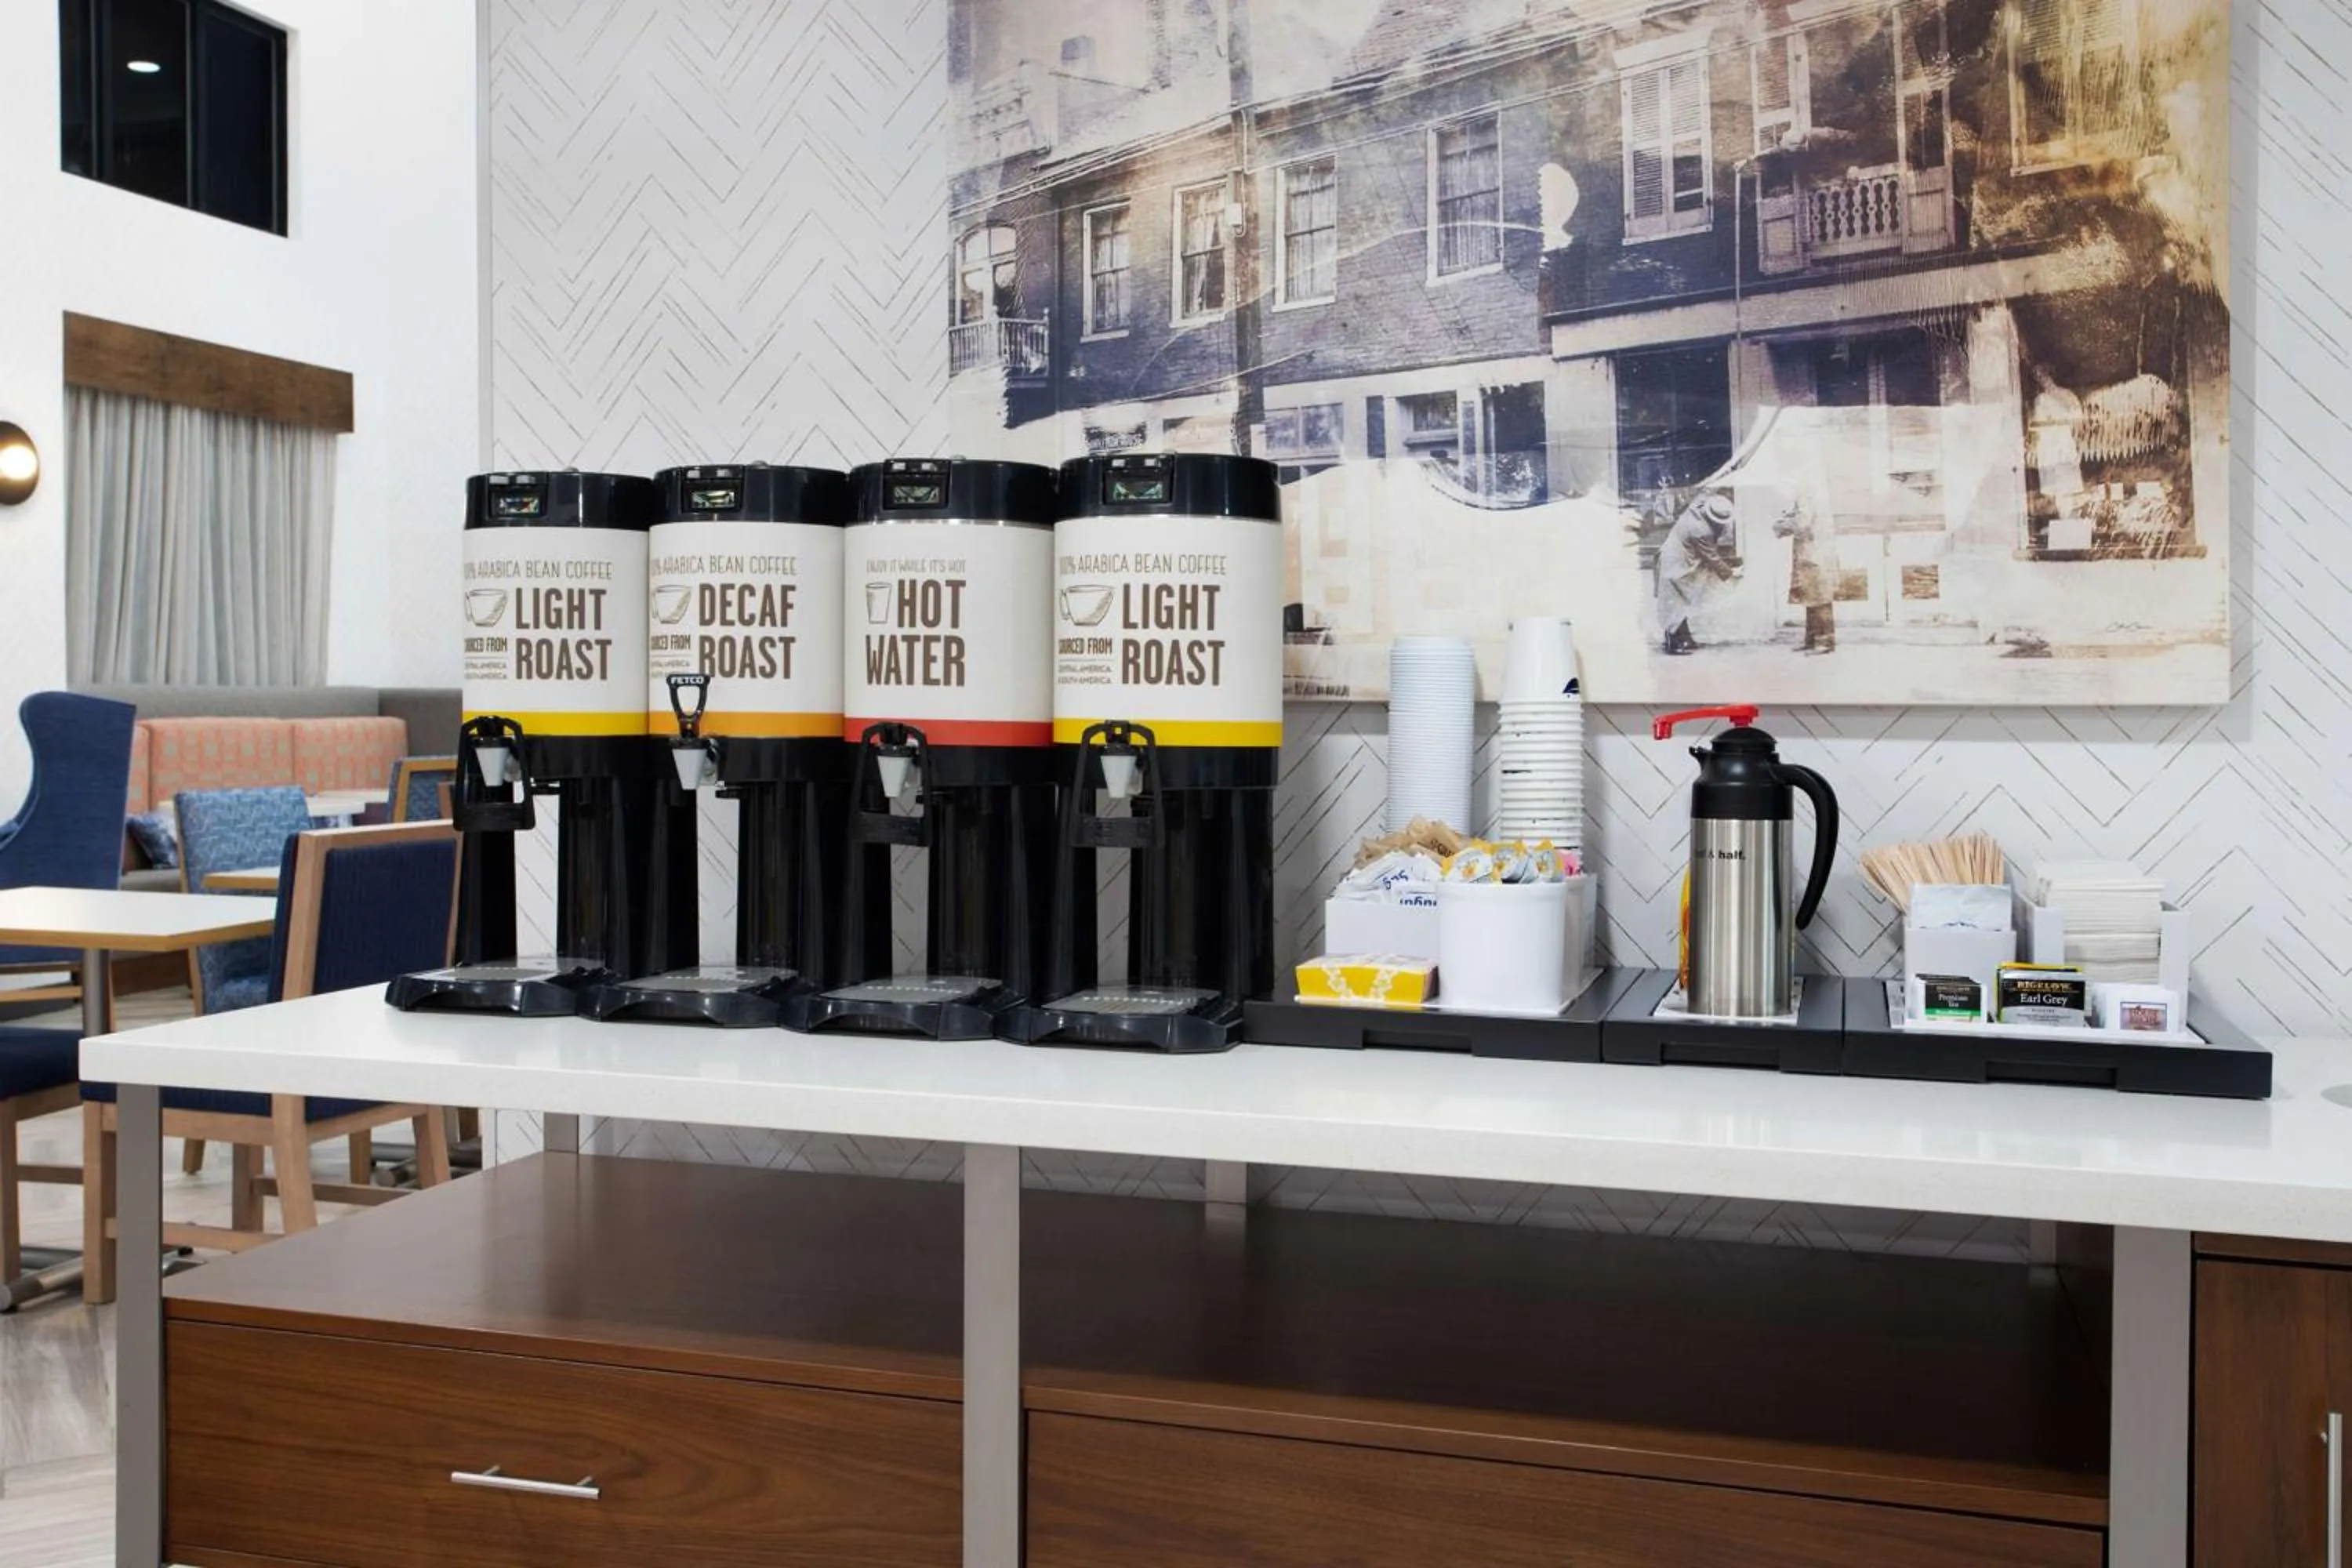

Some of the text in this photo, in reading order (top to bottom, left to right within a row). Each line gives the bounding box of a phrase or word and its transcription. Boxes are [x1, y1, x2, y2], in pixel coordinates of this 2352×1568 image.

[526, 560, 560, 579] BEAN
[565, 561, 612, 580] COFFEE
[710, 554, 744, 574] BEAN
[750, 555, 797, 575] COFFEE
[1078, 554, 1130, 573] ARABICA
[1134, 554, 1172, 573] BEAN
[1178, 554, 1226, 575] COFFEE
[516, 587, 607, 630] LIGHT
[699, 583, 797, 628] DECAF
[898, 579, 967, 629] HOT
[1122, 583, 1221, 630] LIGHT
[486, 637, 508, 653] FROM
[516, 637, 612, 681] ROAST
[699, 634, 796, 680] ROAST
[865, 634, 966, 687] WATER
[1087, 637, 1112, 655] FROM
[1122, 638, 1226, 686] ROAST
[2020, 993, 2068, 1008] Earl Grey
